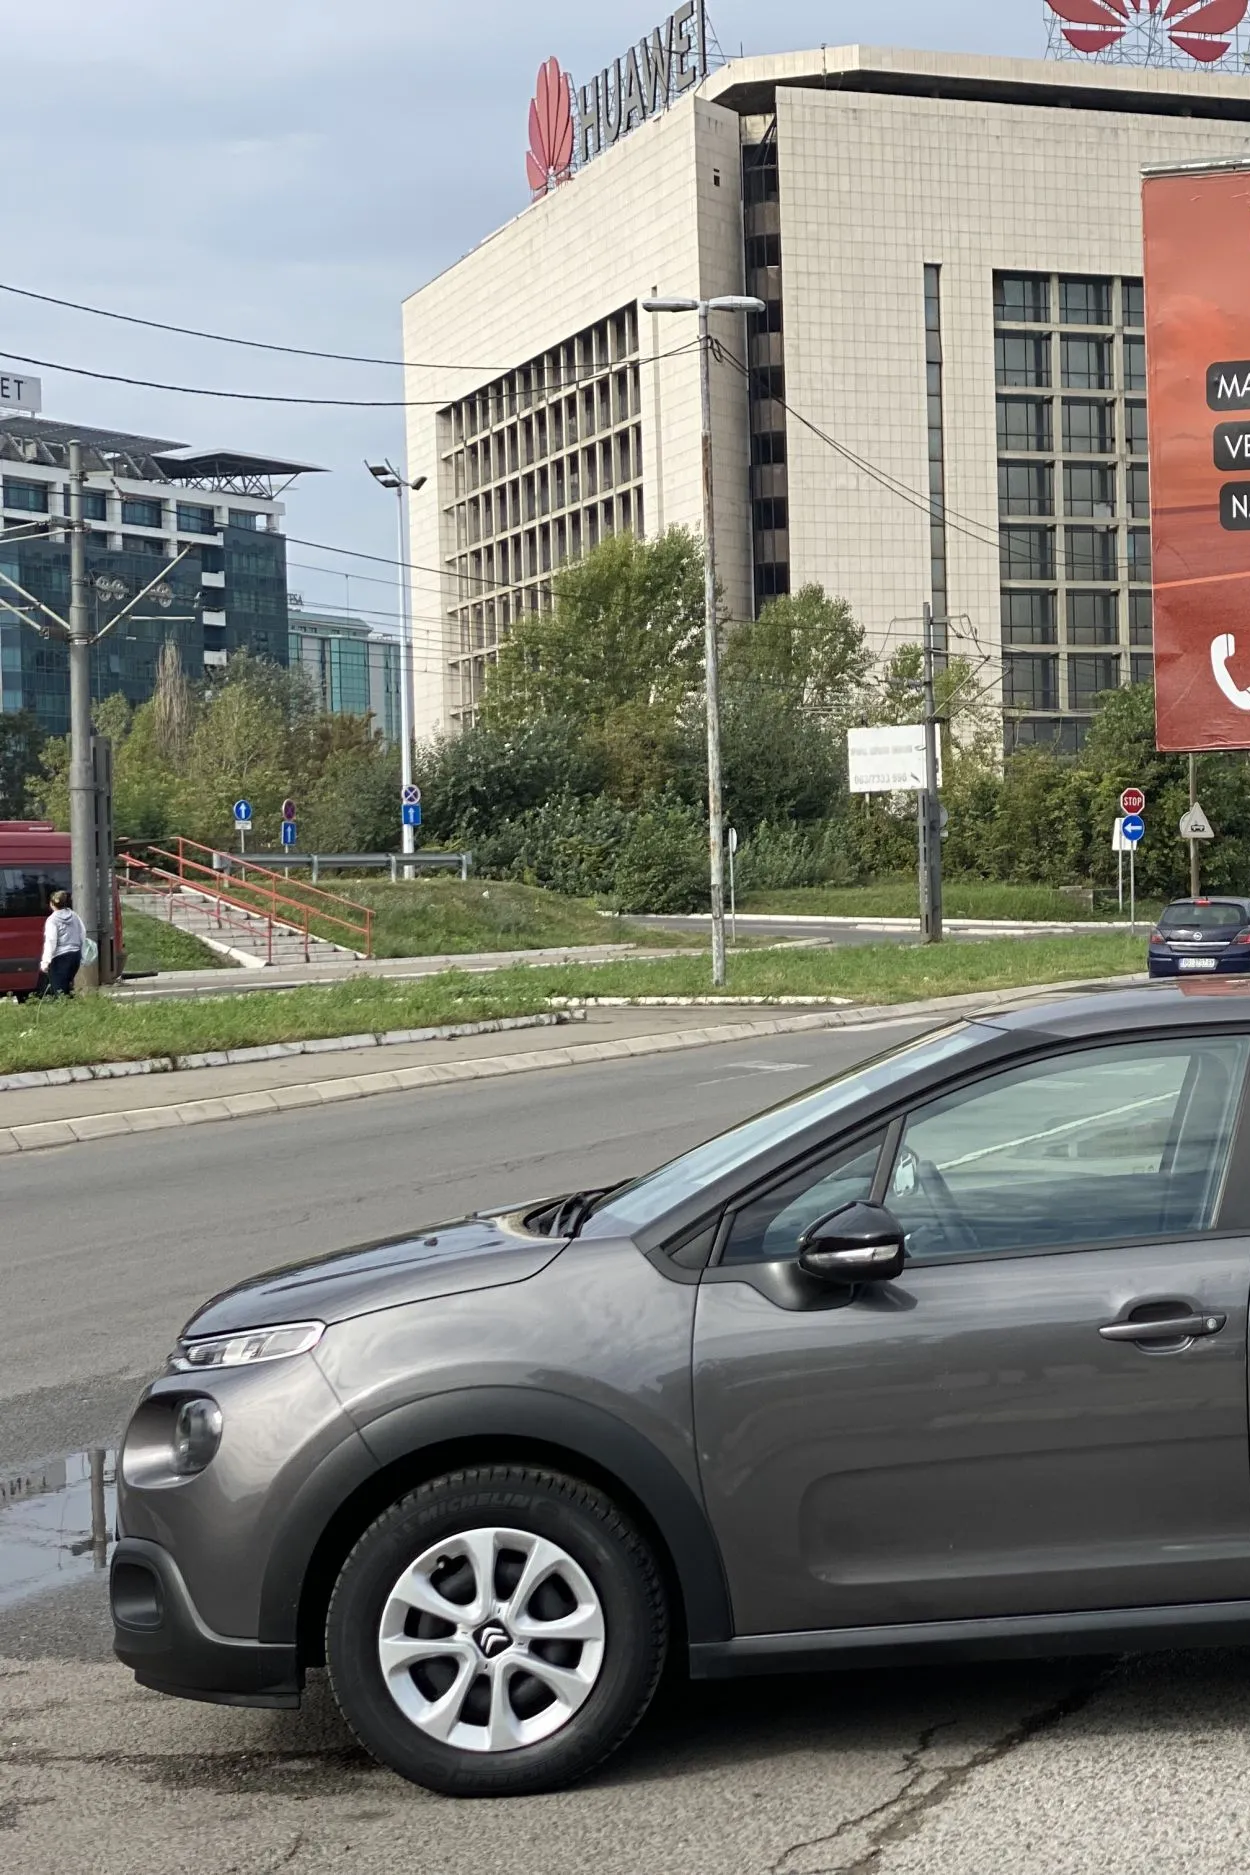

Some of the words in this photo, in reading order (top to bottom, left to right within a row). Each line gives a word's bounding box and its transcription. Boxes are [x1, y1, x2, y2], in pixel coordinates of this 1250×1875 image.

[578, 0, 707, 163] HUAWEI
[1123, 796, 1142, 806] STOP
[417, 1492, 530, 1522] MICHELIN
